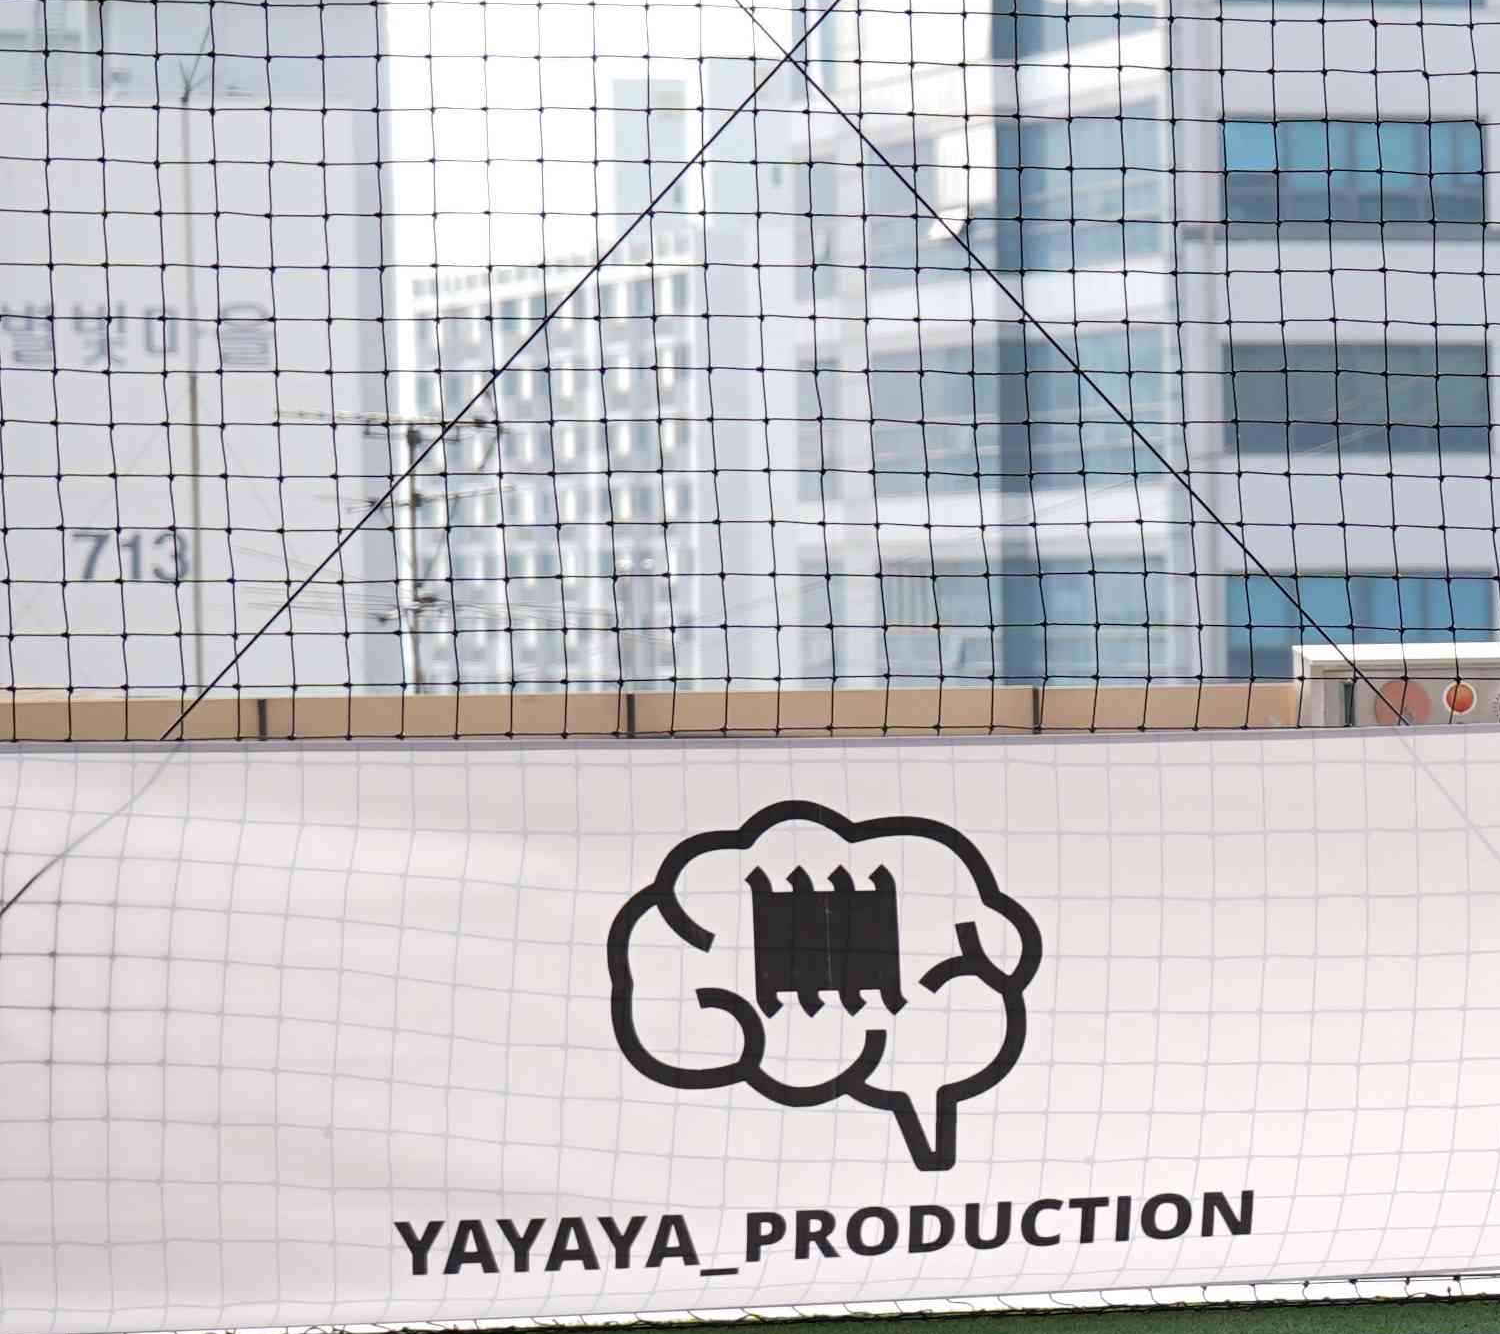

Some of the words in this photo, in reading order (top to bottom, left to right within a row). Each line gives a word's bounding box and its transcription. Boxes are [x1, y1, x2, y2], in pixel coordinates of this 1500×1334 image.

[1, 299, 275, 366] 별빛마을
[71, 533, 191, 582] 713
[394, 1190, 1254, 1277] YAYAYA_PRODUCTION
